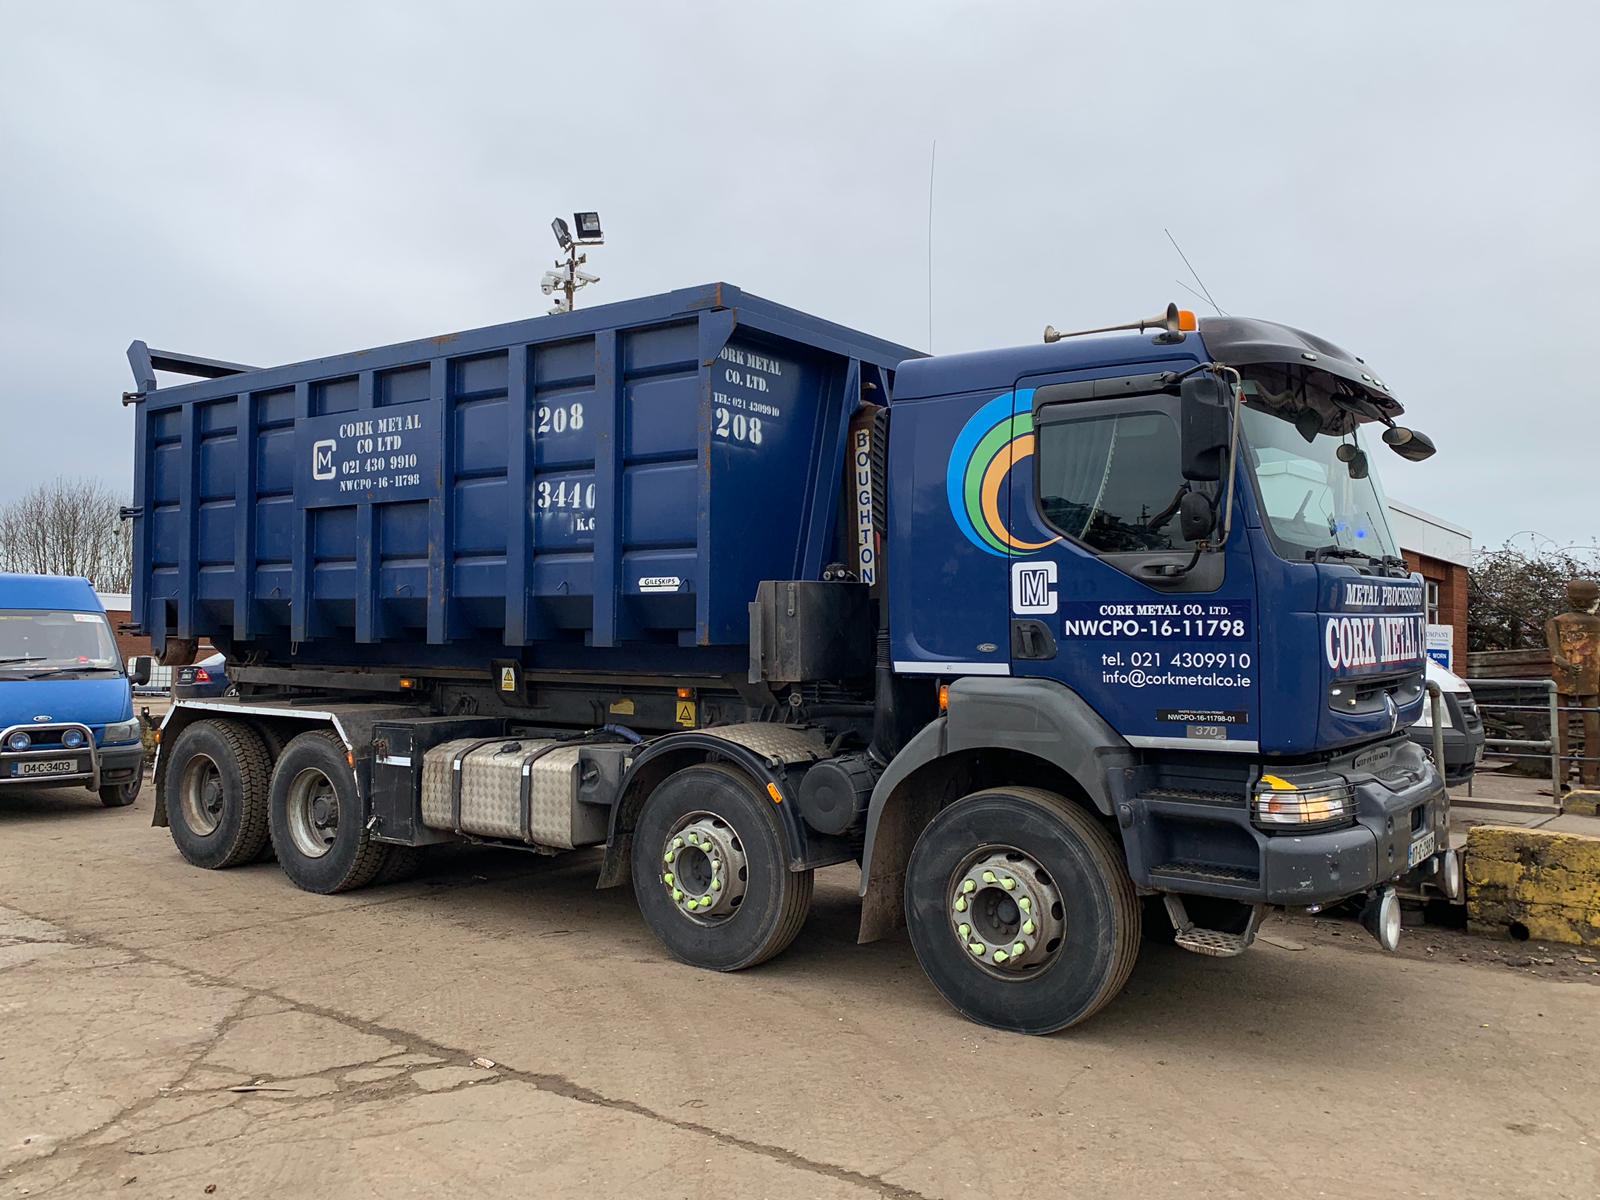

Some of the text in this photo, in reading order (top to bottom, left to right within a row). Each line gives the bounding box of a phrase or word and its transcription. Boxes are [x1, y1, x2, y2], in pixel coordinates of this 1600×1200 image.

[718, 347, 781, 376] ORK METAL
[725, 368, 769, 392] CO. LTD.
[732, 397, 746, 409] 021
[748, 401, 779, 417] 4309910
[339, 415, 421, 438] CORK METAL
[538, 403, 584, 434] 208
[715, 407, 762, 445] 208
[357, 435, 402, 454] CO LTD
[342, 454, 417, 475] 021 430 9910
[856, 432, 873, 584] BOUGHTON
[1345, 583, 1379, 606] METAL
[1099, 604, 1231, 616] CORK METAL CO. LTD.
[1064, 619, 1246, 637] NWCPO-16-11798
[1325, 617, 1376, 669] CORK
[1379, 617, 1418, 663] METAL
[1101, 651, 1250, 669] tel. 021 4309910
[1102, 669, 1251, 688] info@corkmetalco.ie
[1167, 714, 1236, 723] NWCPO-16-11798-01
[1195, 725, 1219, 736] 370
